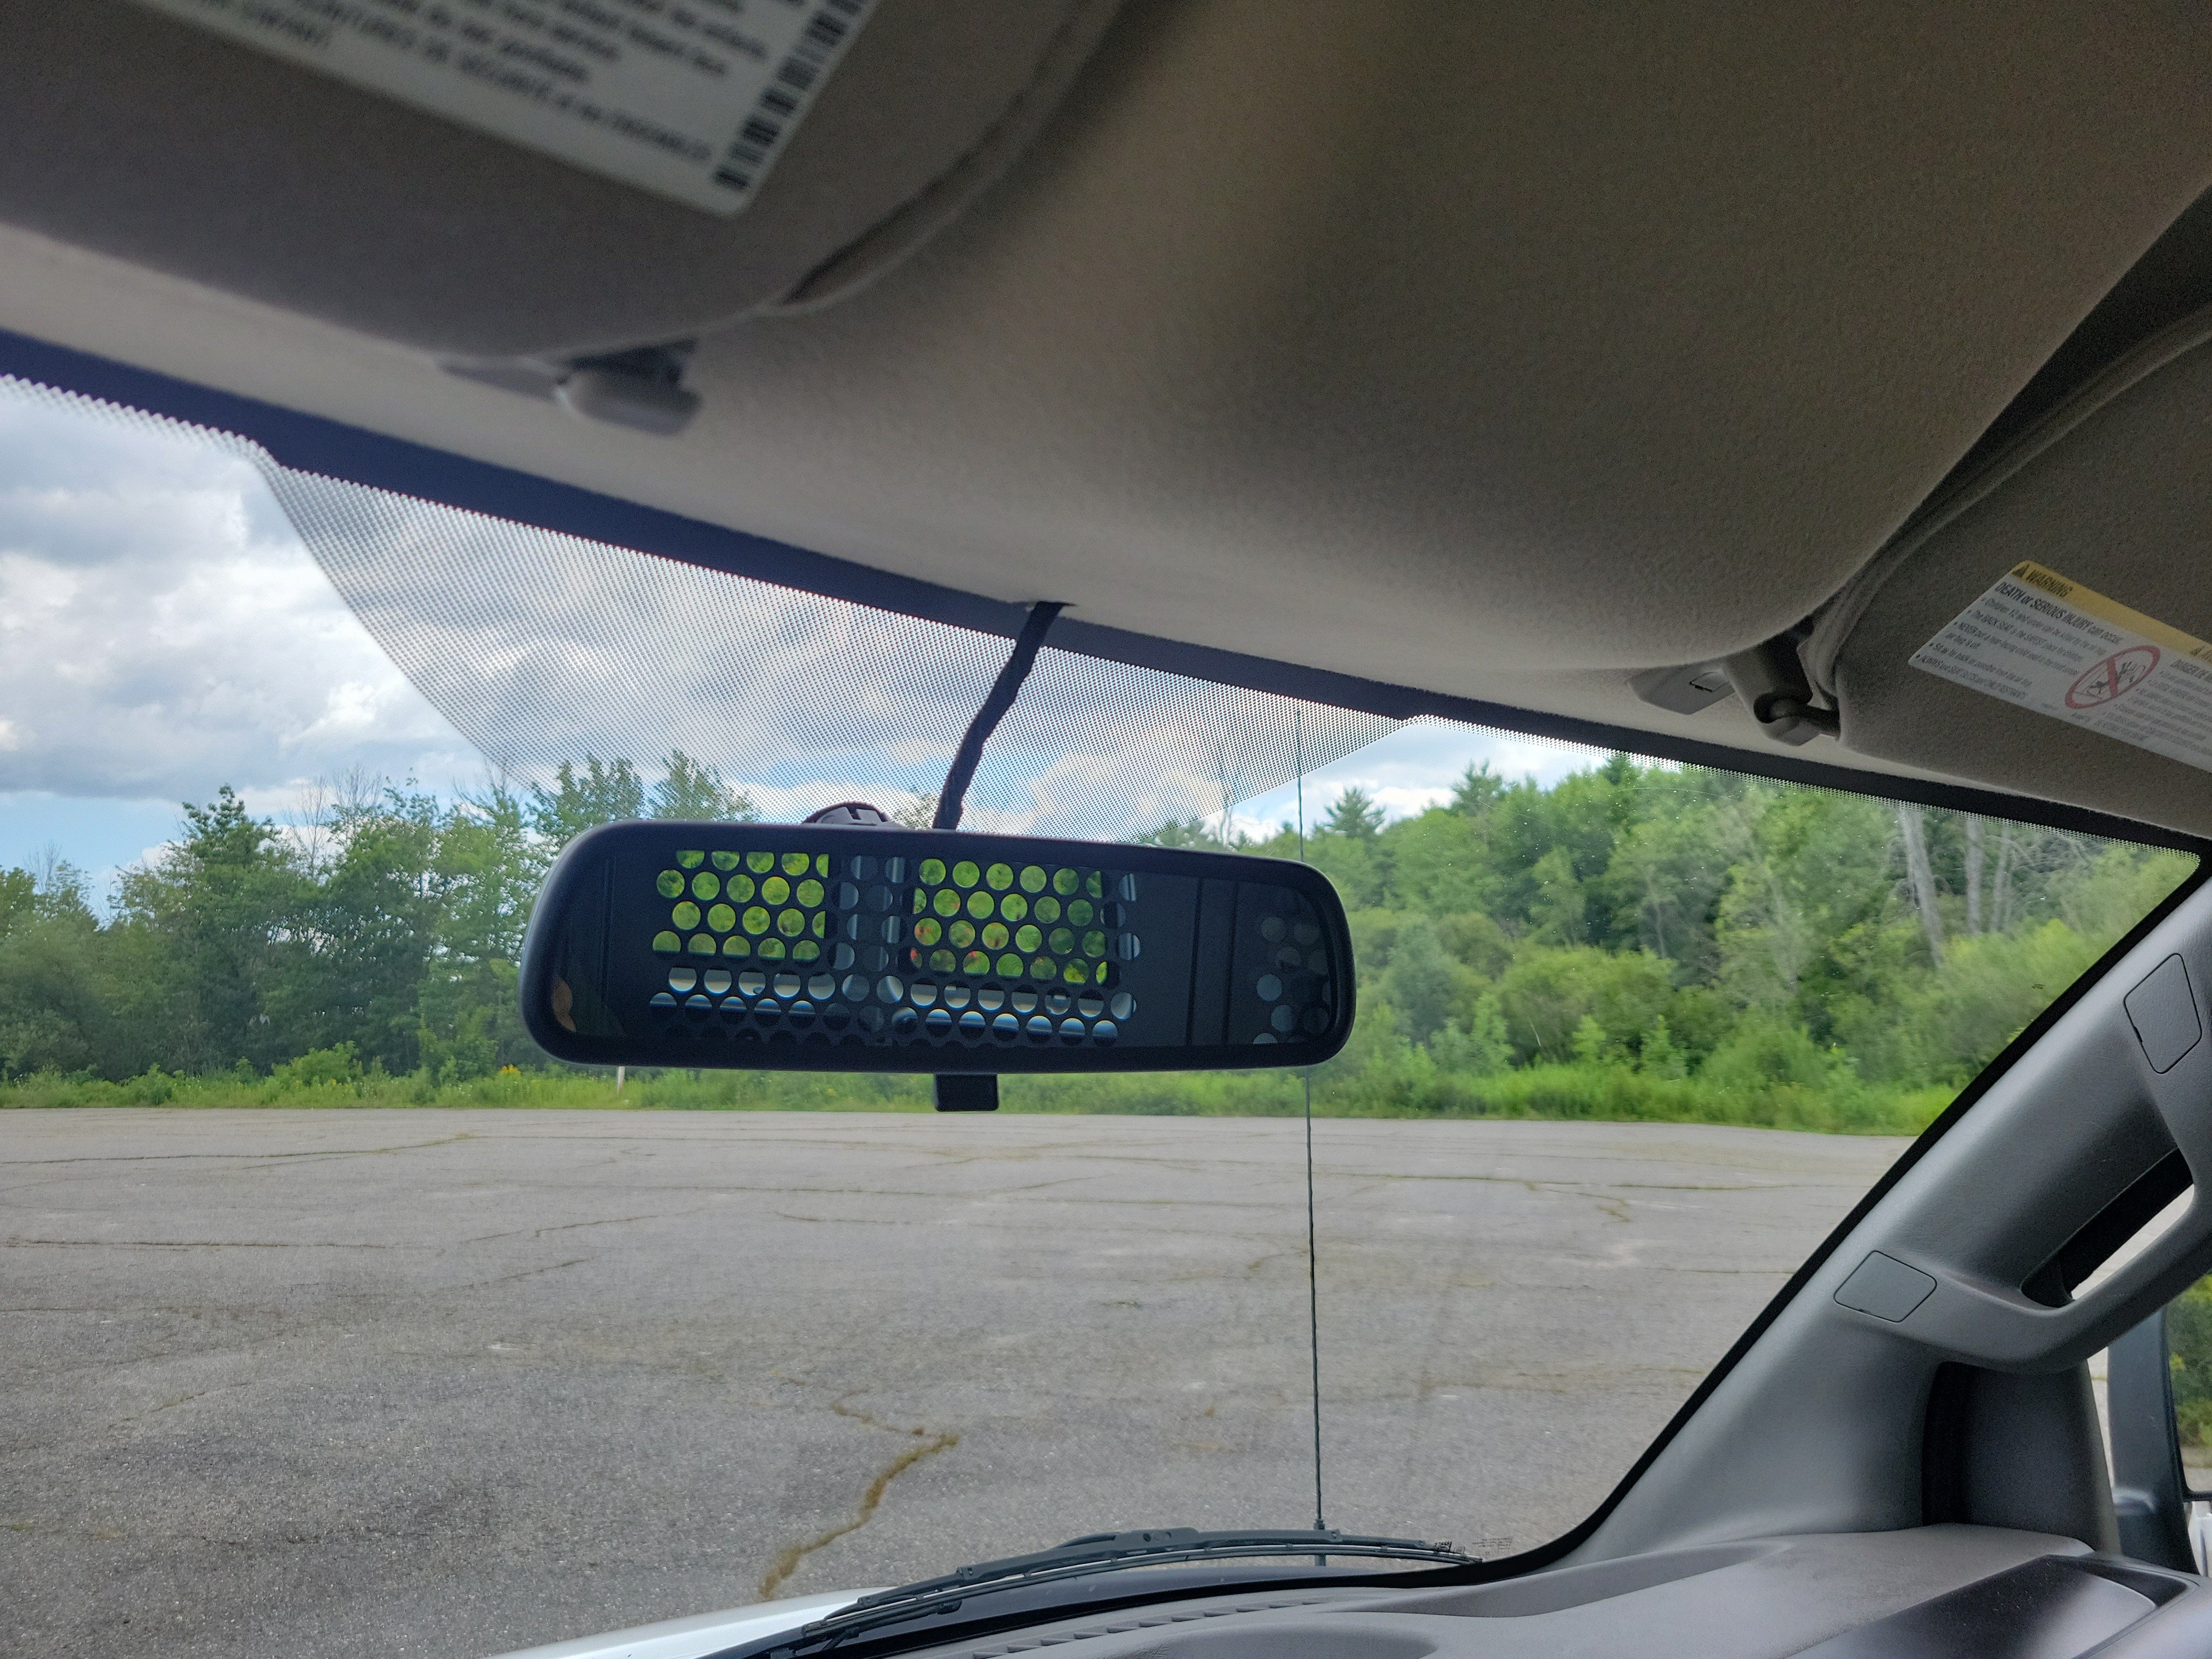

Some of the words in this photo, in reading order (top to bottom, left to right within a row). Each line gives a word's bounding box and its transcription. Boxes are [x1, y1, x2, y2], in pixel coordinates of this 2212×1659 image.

[2024, 570, 2073, 597] WARNING
[1994, 582, 2025, 600] DEATH
[2020, 595, 2033, 604] or
[2029, 598, 2067, 619] SERIOUS
[2061, 613, 2092, 630] INJURY
[1956, 622, 1978, 634] NEVER
[1980, 614, 2000, 626] BACK
[1995, 621, 2013, 631] SEAT
